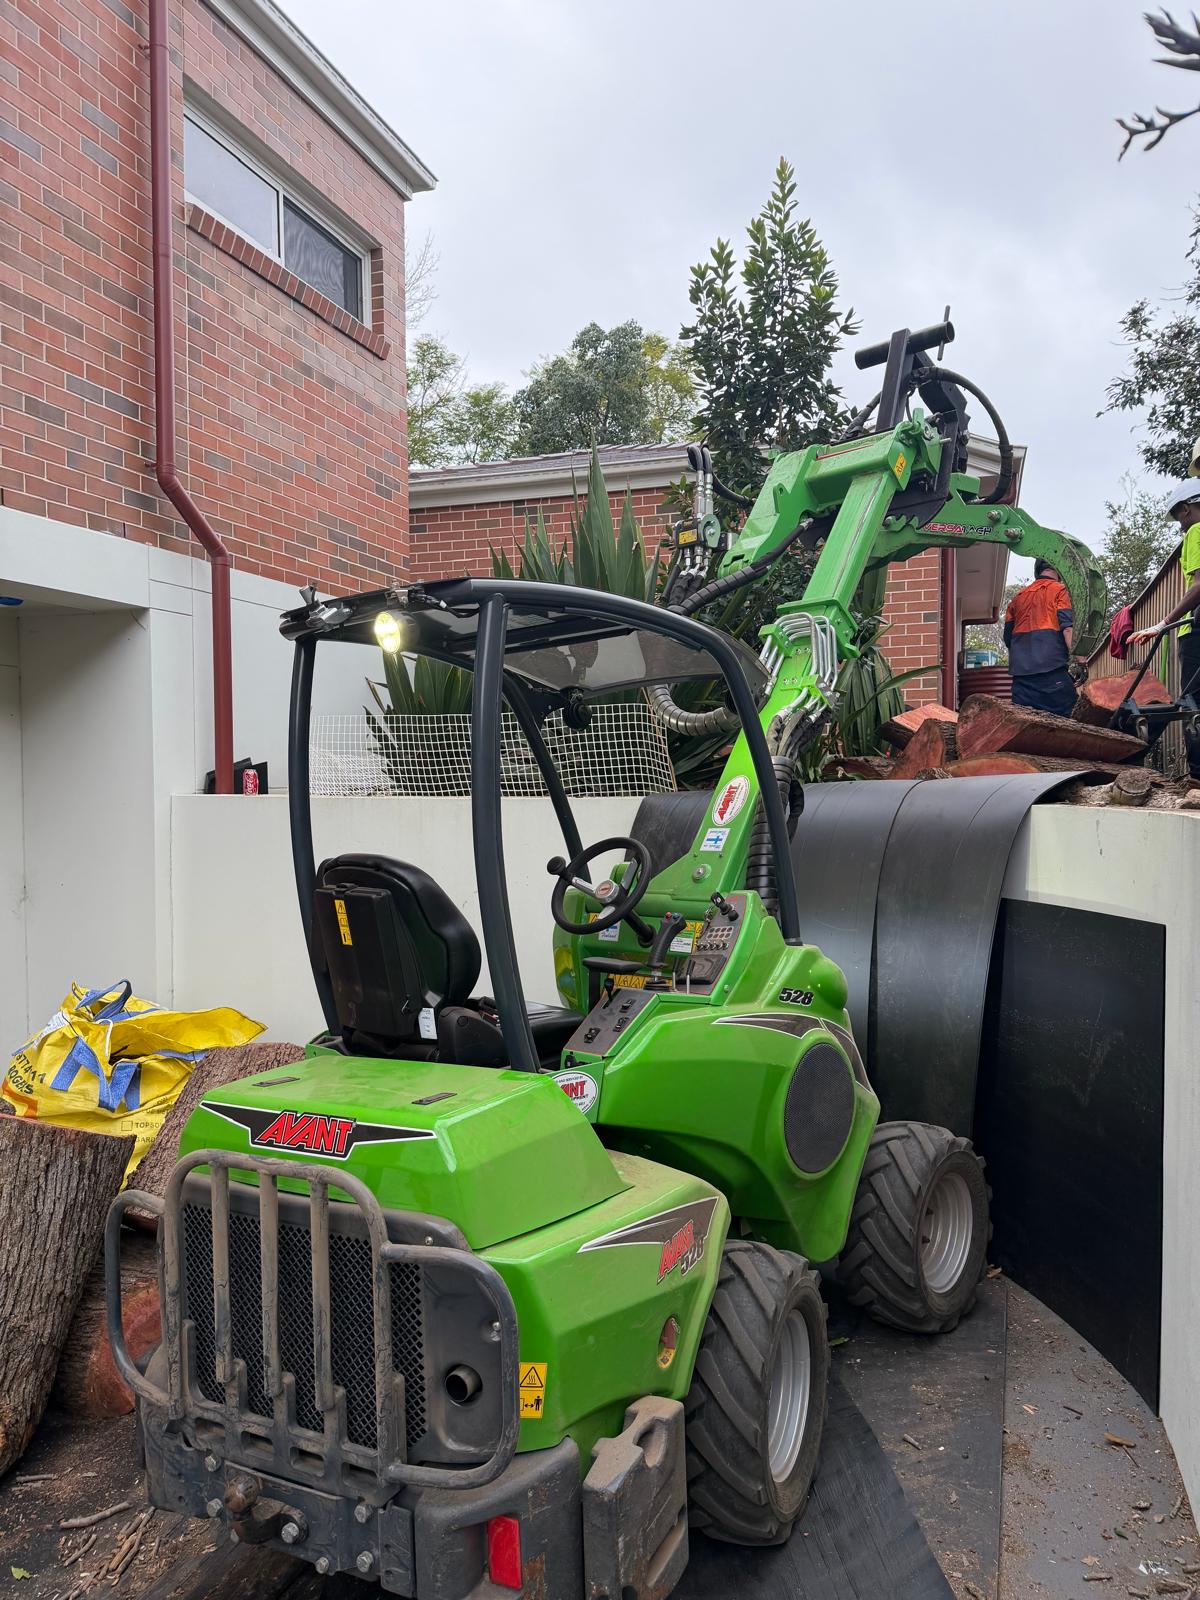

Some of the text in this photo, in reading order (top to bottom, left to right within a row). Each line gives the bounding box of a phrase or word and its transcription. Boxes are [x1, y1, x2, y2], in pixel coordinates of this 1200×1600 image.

[717, 784, 738, 821] AVANT
[779, 987, 814, 1006] 528
[256, 1112, 354, 1154] AVANT
[657, 1220, 694, 1282] AVANT
